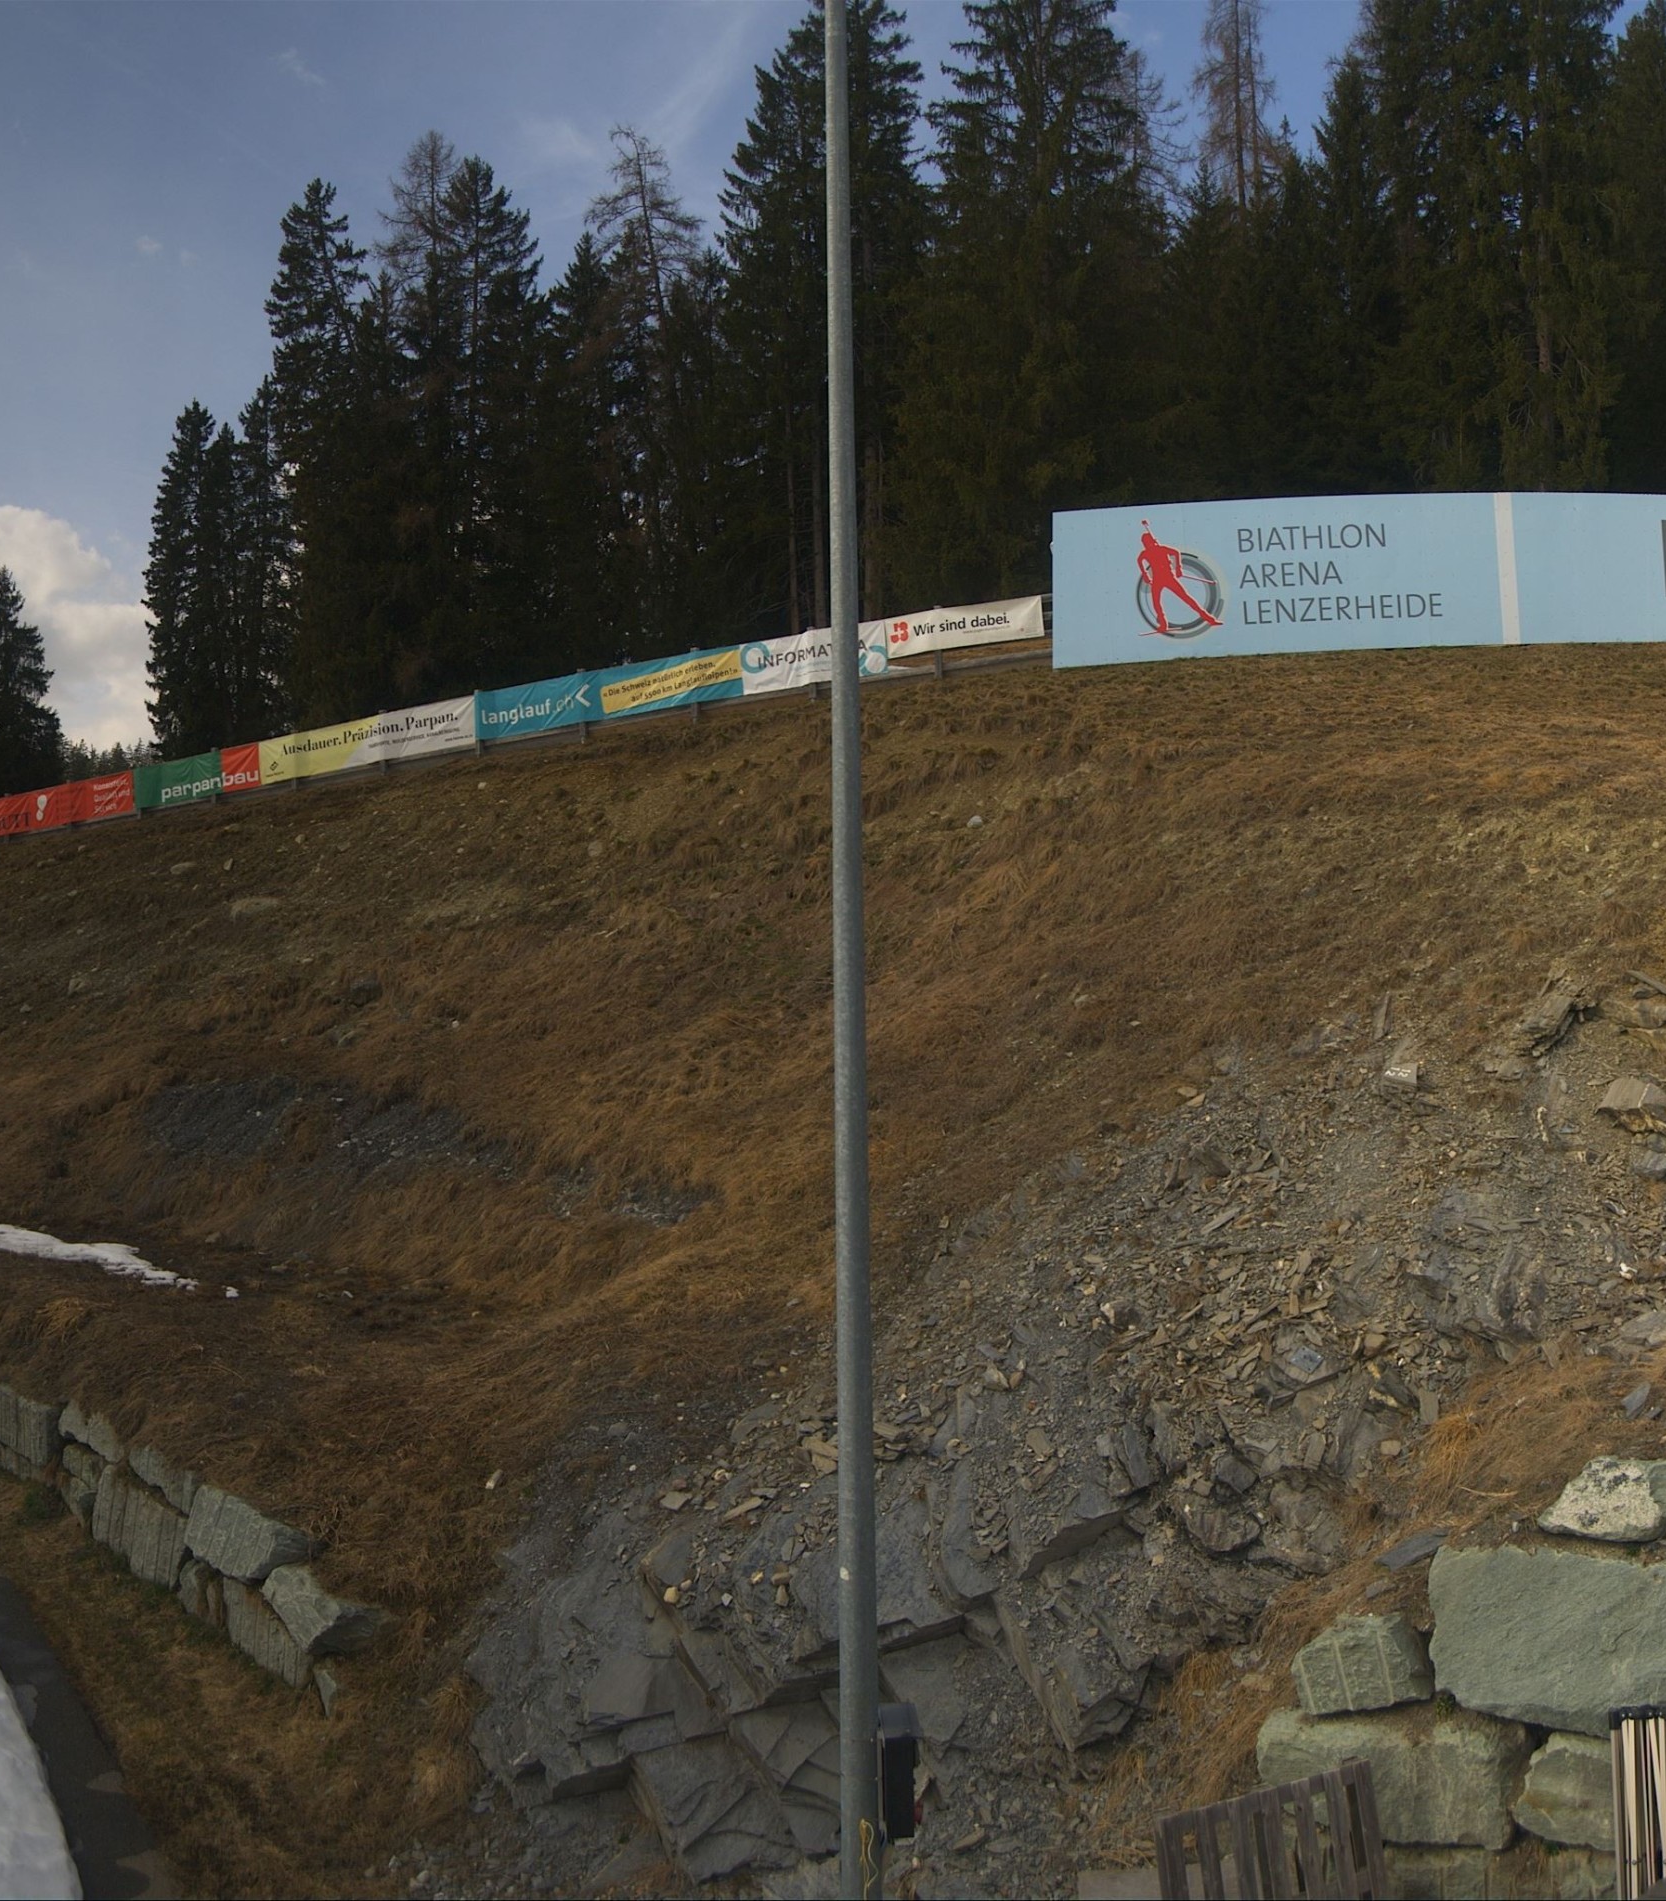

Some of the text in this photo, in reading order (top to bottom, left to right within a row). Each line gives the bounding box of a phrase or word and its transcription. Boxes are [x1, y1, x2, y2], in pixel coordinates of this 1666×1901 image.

[1237, 523, 1386, 553] BIATHLON
[1239, 560, 1343, 589] ARENA
[1243, 593, 1443, 625] LENZERHEIDE
[913, 623, 935, 637] Wir
[939, 617, 966, 633] sind
[970, 612, 1010, 628] dabei.
[622, 680, 652, 693] Schweiz
[631, 692, 644, 702] auf
[645, 689, 662, 700] 5500
[662, 684, 673, 693] km
[482, 693, 575, 726] langlauf.ch
[282, 737, 341, 757] Ausdauer.
[343, 723, 403, 745] Präzision.
[405, 712, 458, 731] Parpan.
[161, 770, 259, 802] parpanbau
